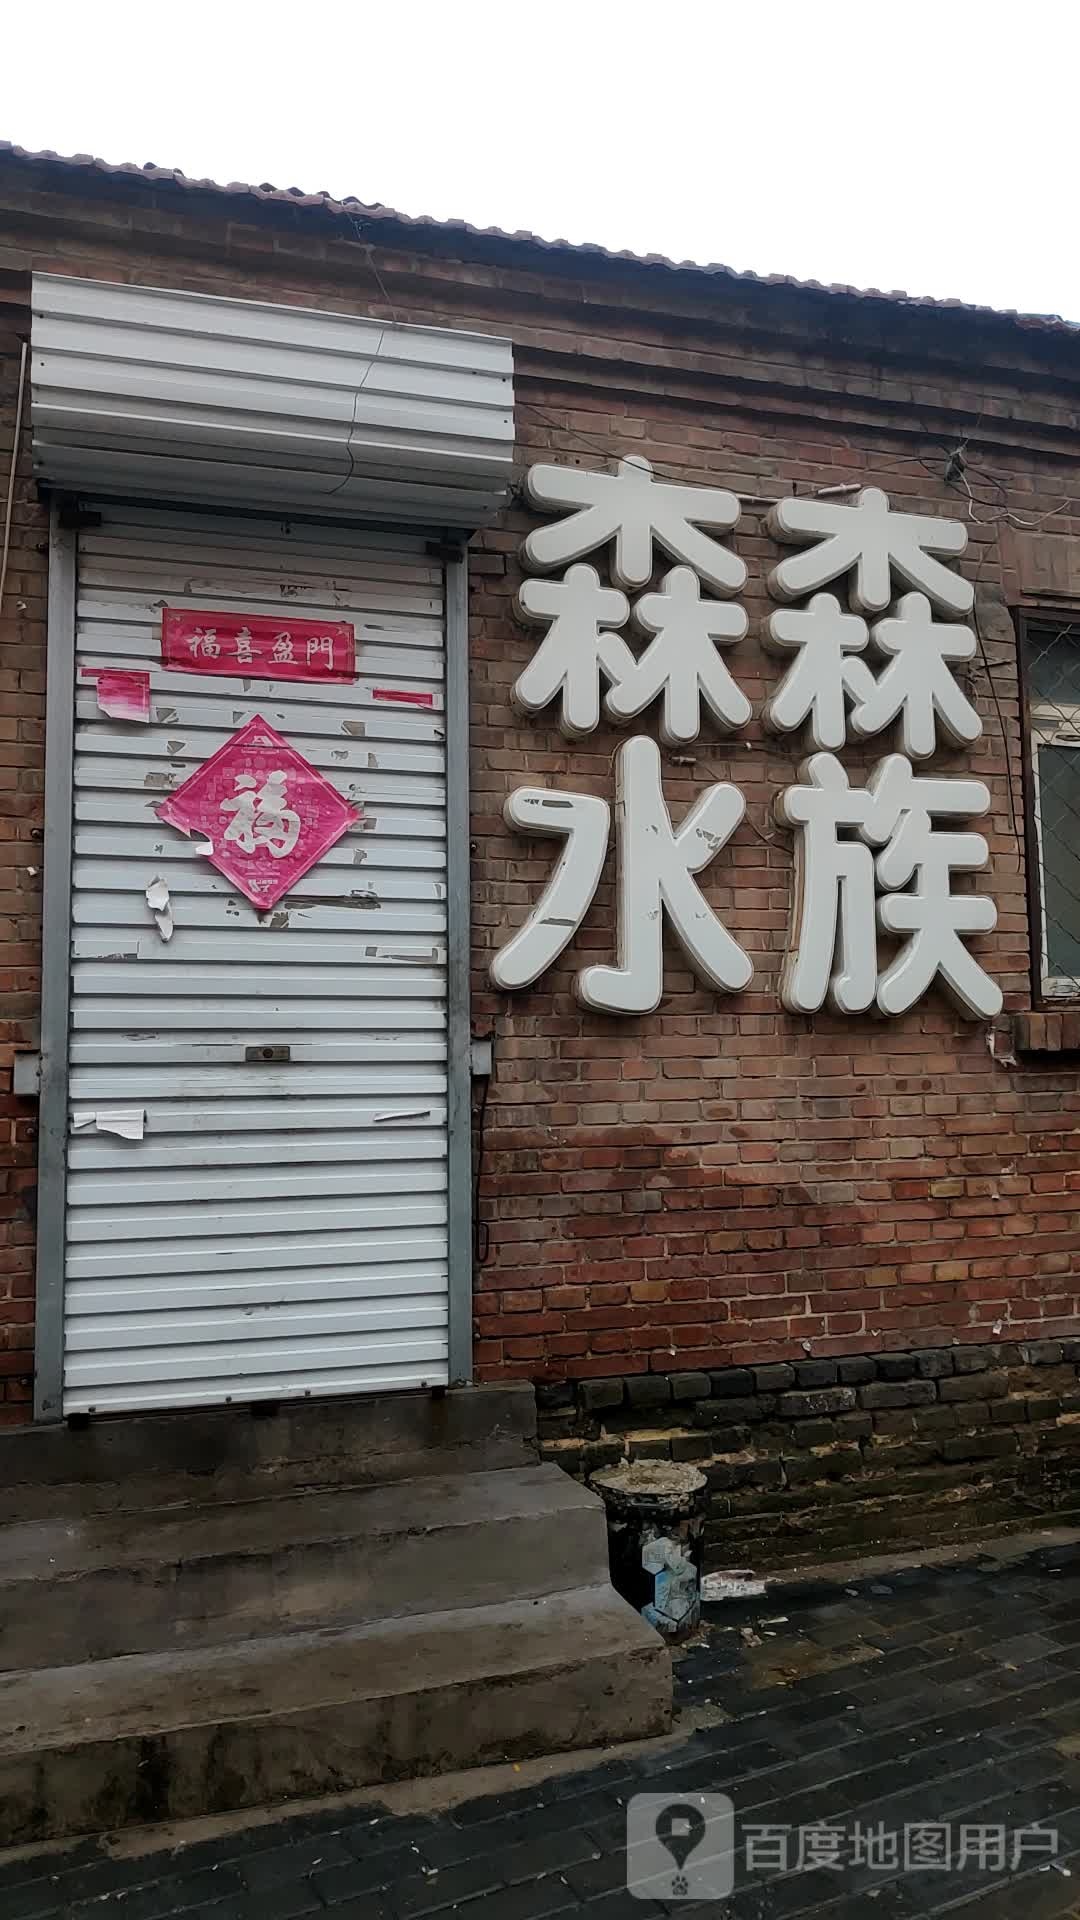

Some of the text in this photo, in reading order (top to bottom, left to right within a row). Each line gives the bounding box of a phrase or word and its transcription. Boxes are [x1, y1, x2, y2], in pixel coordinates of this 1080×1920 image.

[185, 627, 335, 670] 福喜盈門
[514, 453, 984, 761] 森森
[219, 769, 301, 859] 福
[489, 735, 1004, 1021] 水族
